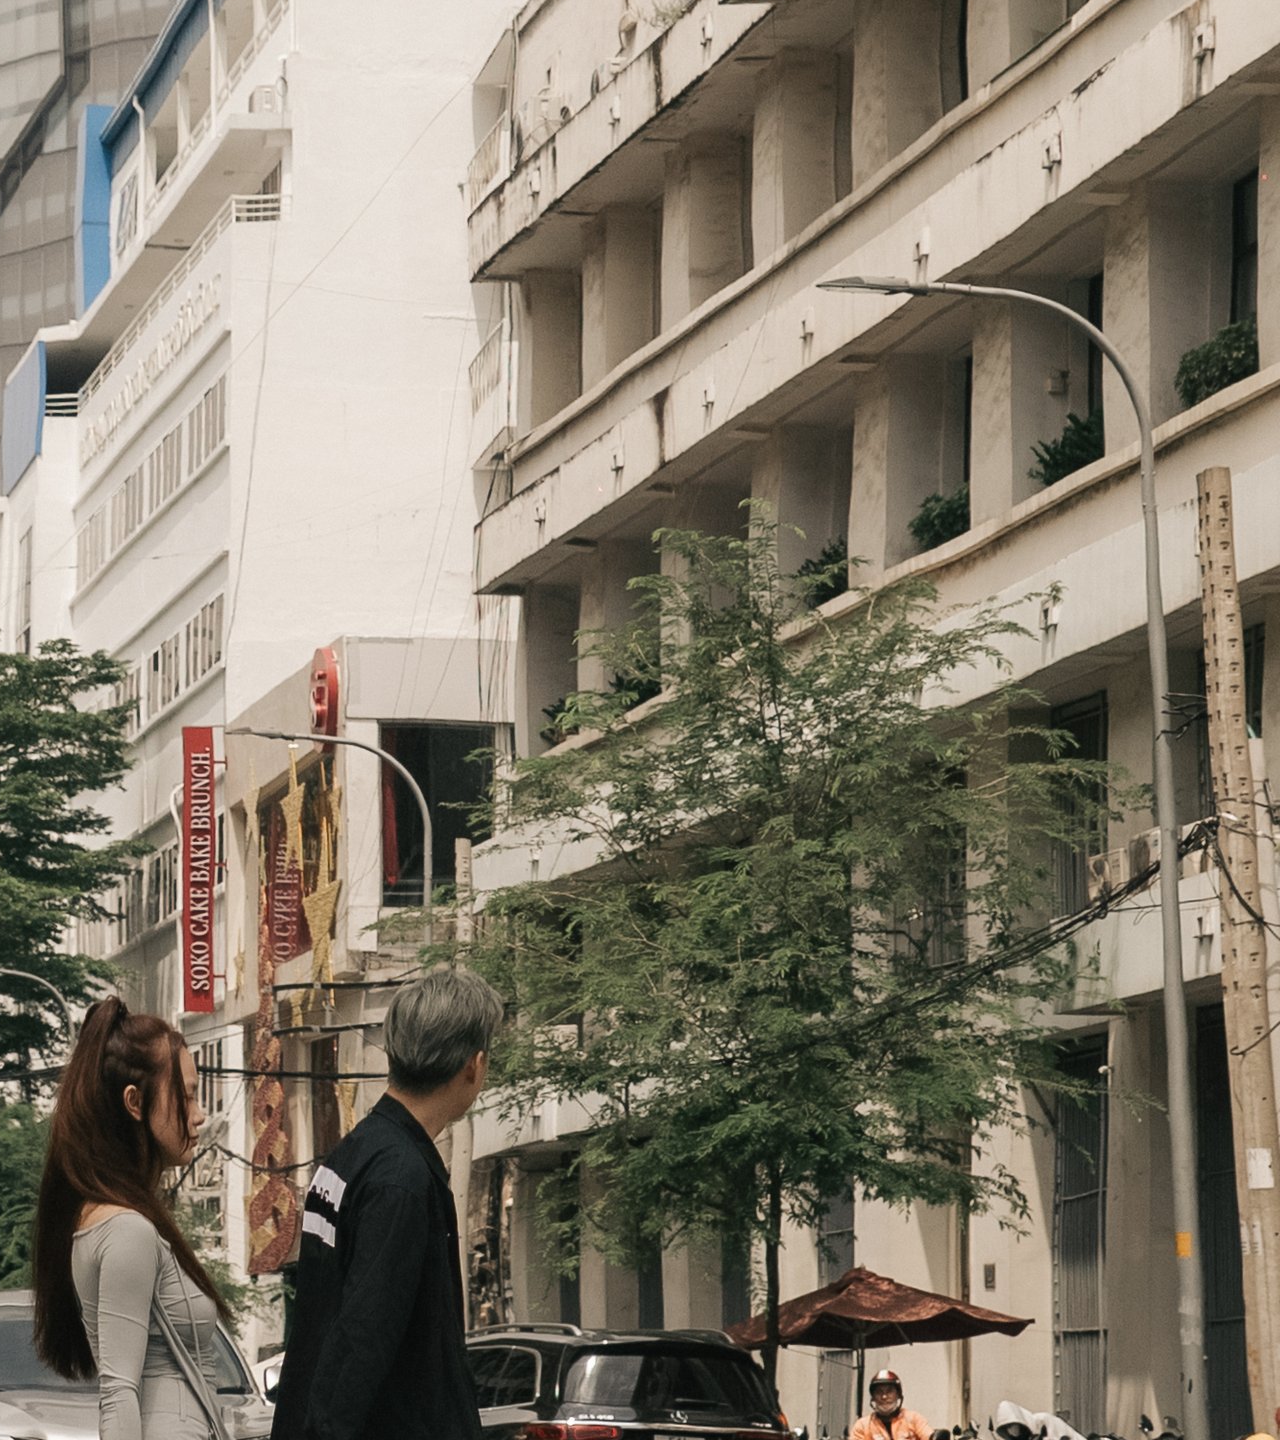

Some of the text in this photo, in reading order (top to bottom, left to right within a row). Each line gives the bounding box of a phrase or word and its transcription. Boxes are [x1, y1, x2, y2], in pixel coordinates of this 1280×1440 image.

[189, 746, 211, 991] SOKO CAKE BAKE BRUNCH.
